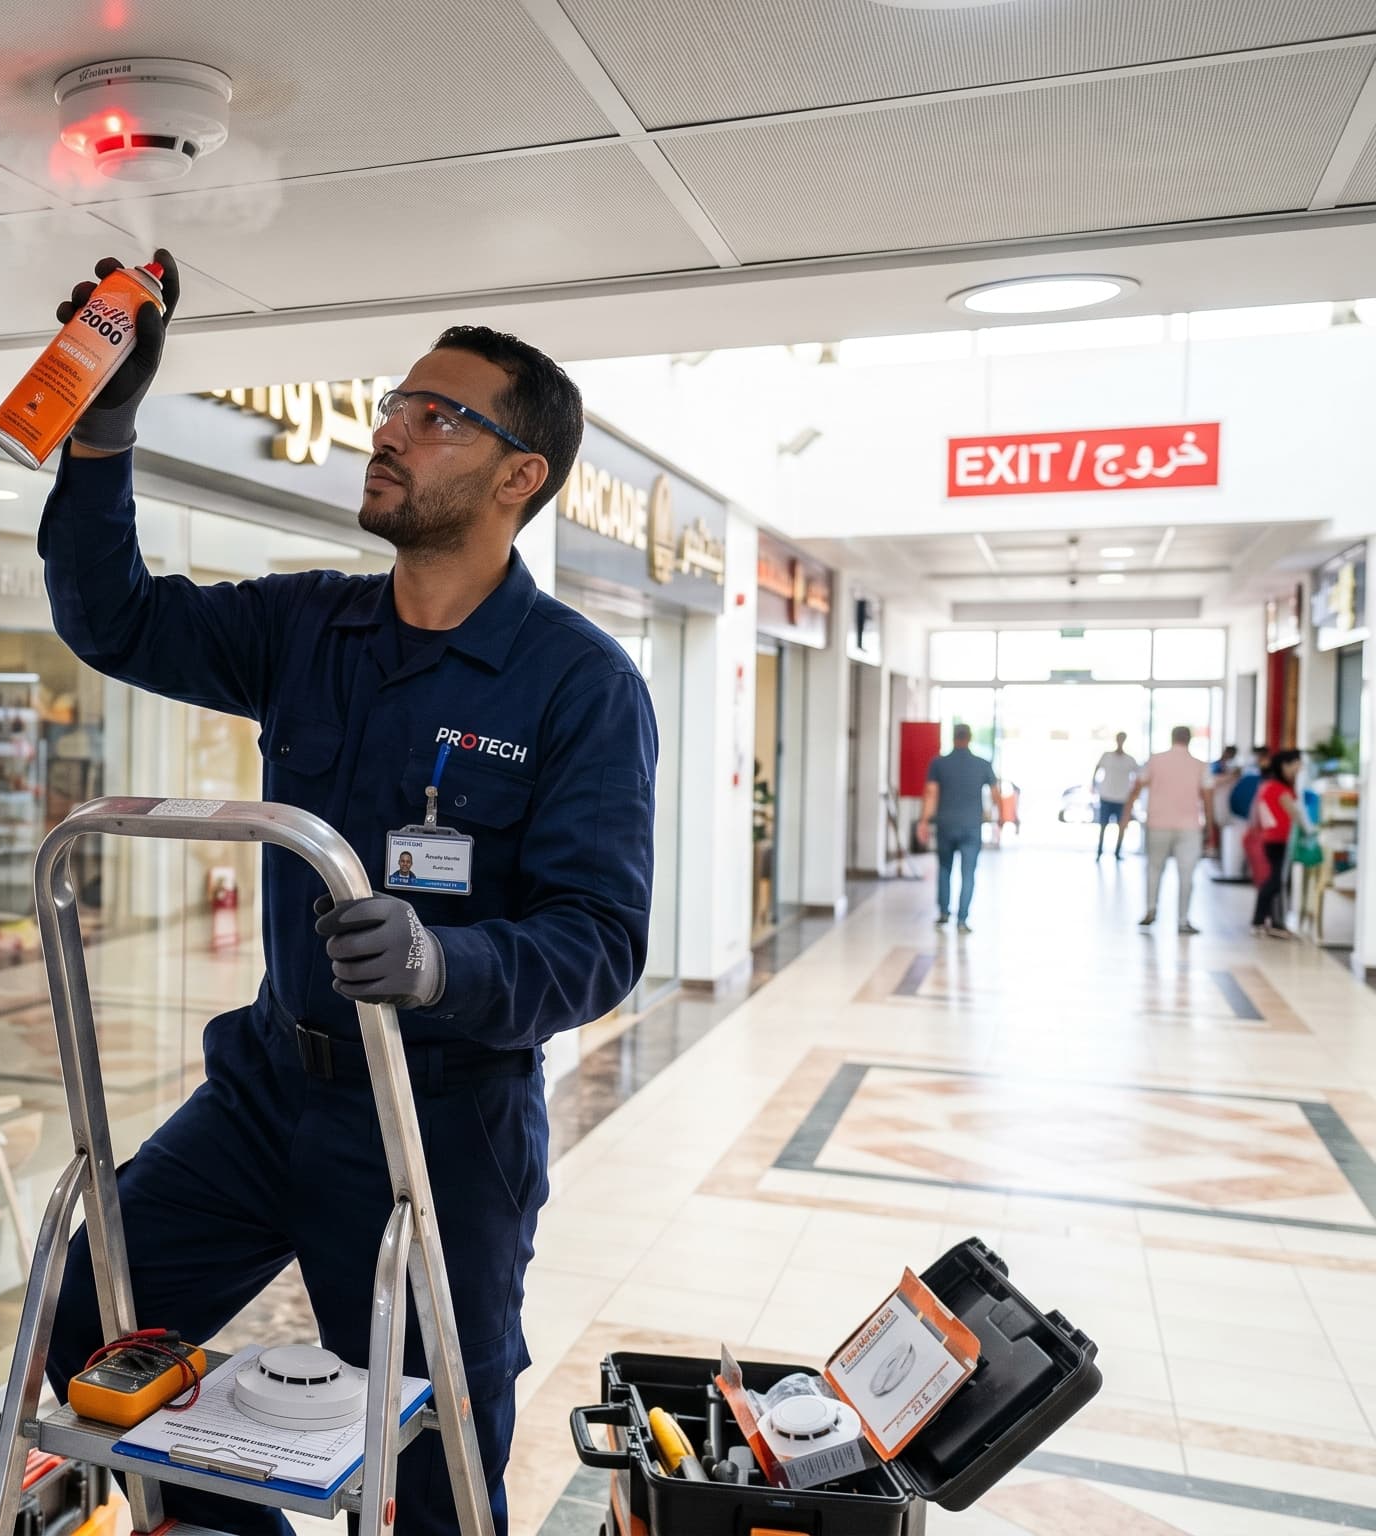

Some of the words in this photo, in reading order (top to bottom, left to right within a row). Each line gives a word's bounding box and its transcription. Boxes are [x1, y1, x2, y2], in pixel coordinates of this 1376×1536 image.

[79, 309, 123, 346] 2000
[955, 441, 1062, 487] EXIT
[1067, 439, 1087, 482] /
[1093, 430, 1209, 488] خروج
[565, 457, 648, 551] ARCADE
[435, 727, 528, 763] PROTECH
